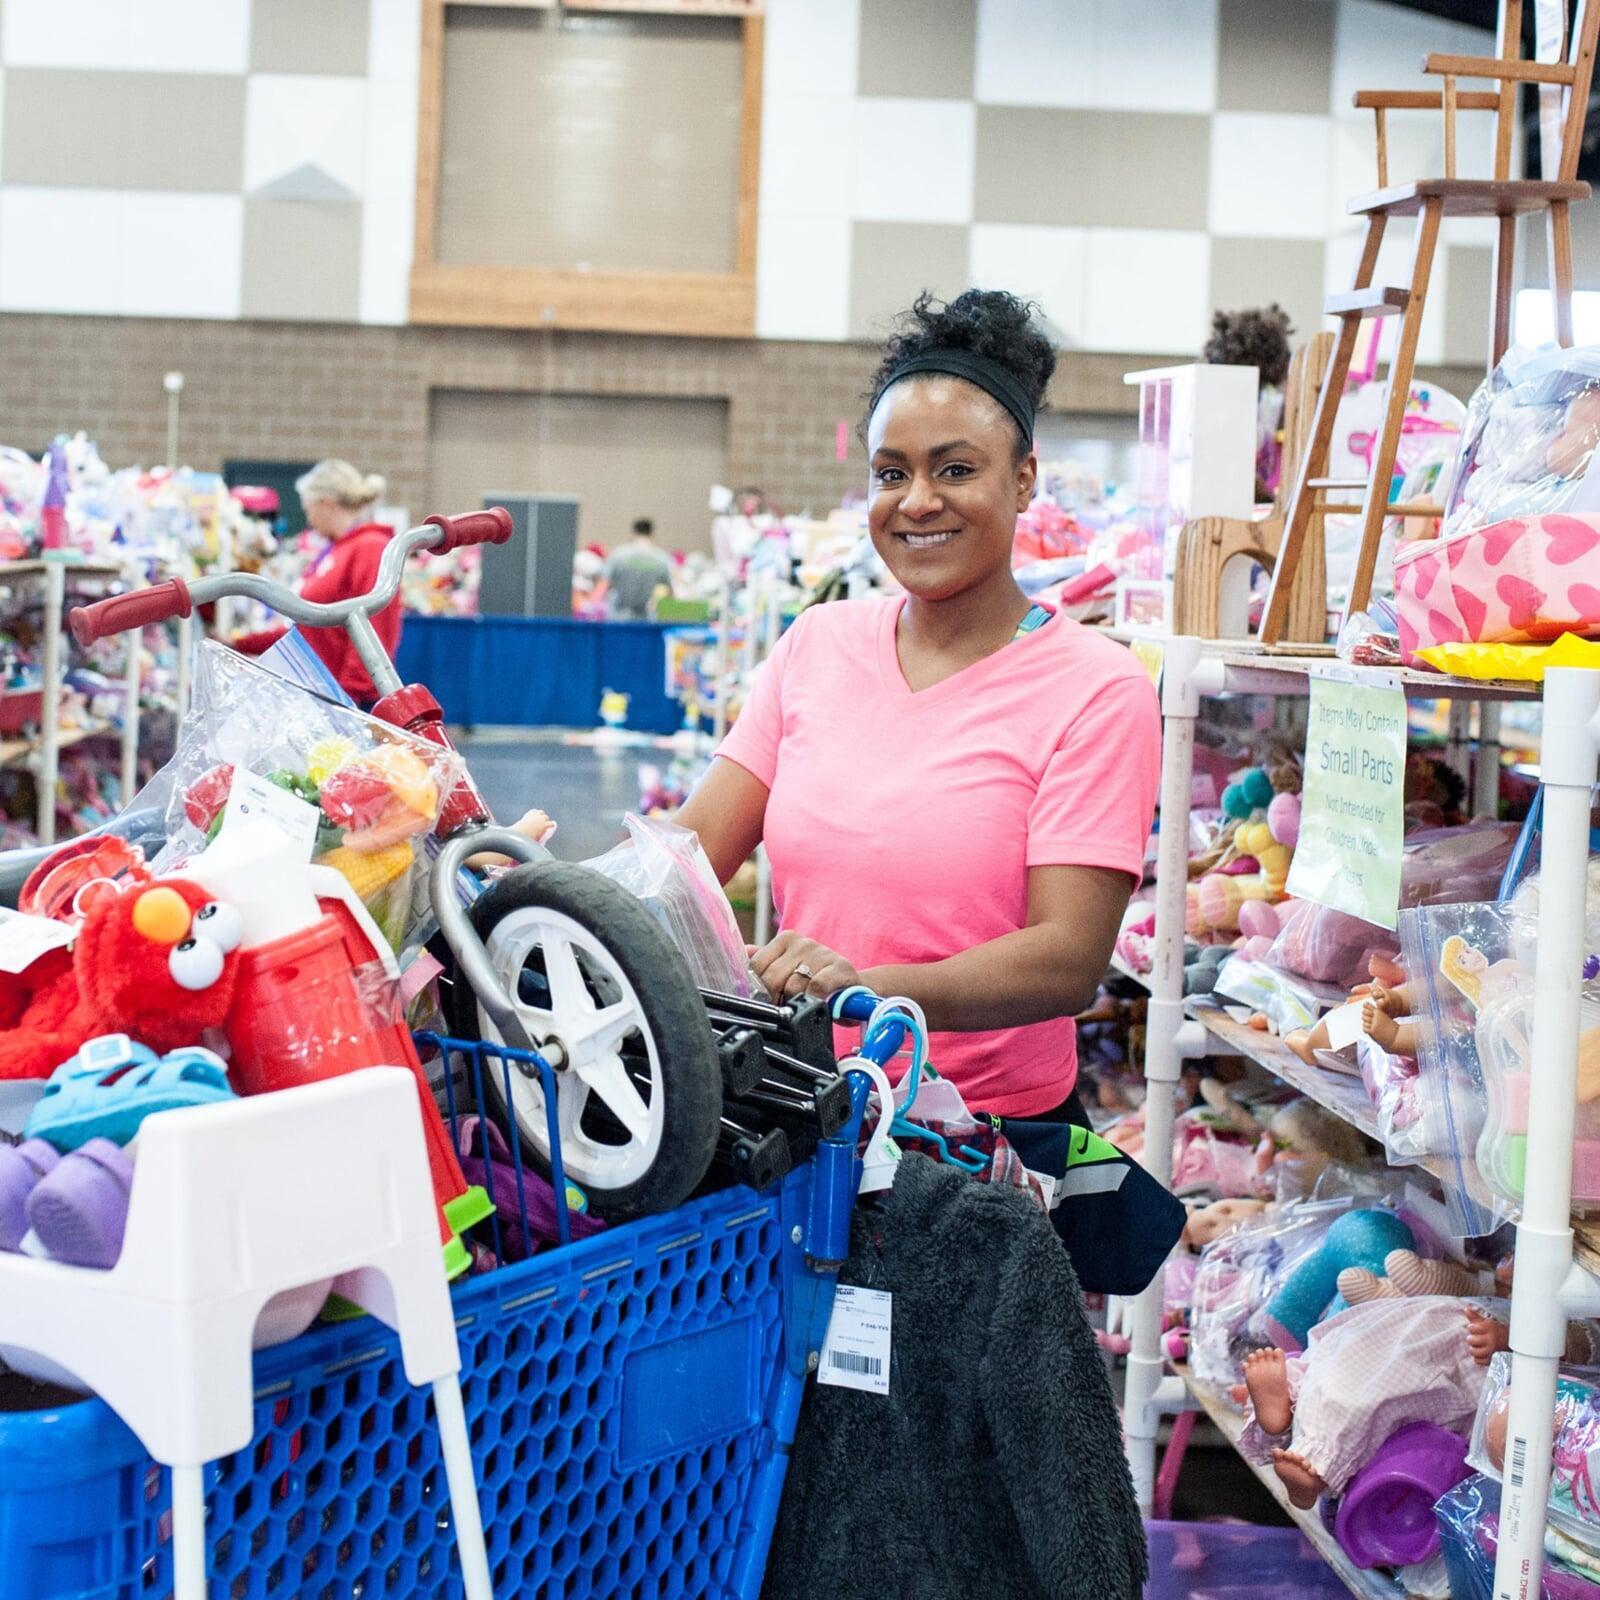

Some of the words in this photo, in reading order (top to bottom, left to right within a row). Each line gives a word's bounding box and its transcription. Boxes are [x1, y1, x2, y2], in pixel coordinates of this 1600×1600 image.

[1319, 703, 1344, 727] Items
[1345, 708, 1363, 733] May
[1366, 710, 1400, 734] Contain
[1320, 742, 1358, 777] Small
[1361, 751, 1394, 786] Parts
[1325, 793, 1338, 812] Not
[1338, 797, 1374, 822] Intended
[1374, 806, 1386, 825] for
